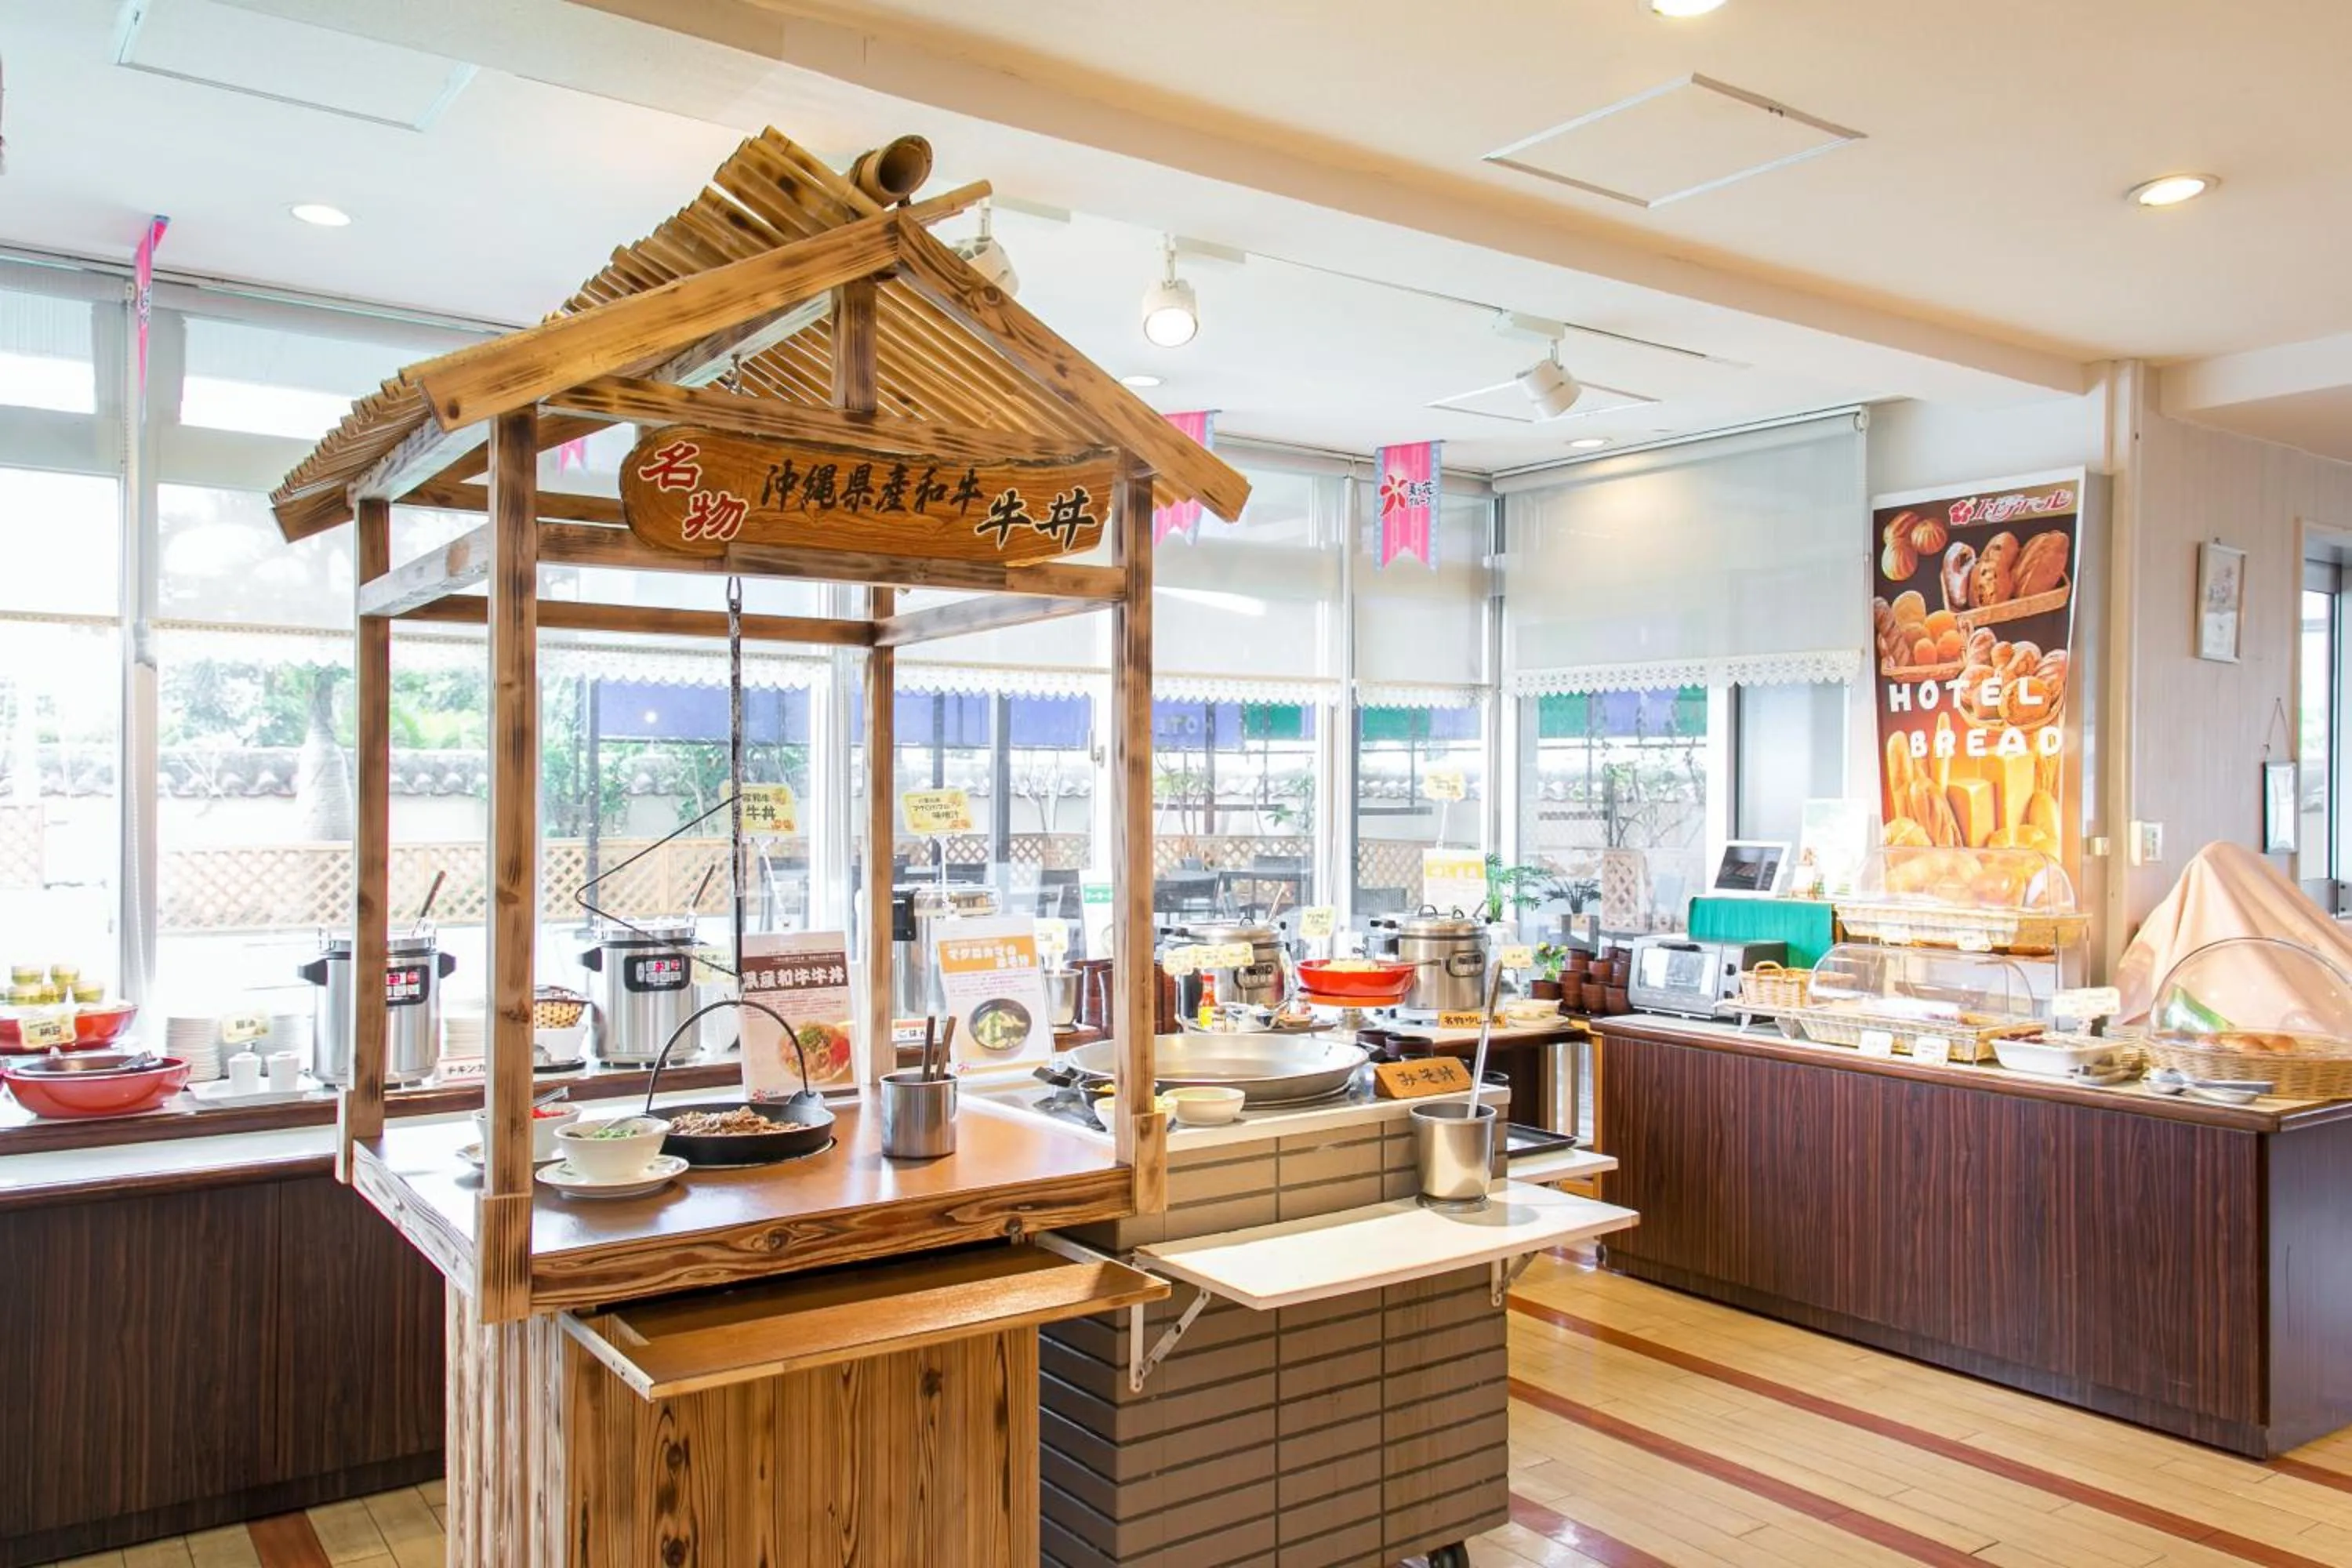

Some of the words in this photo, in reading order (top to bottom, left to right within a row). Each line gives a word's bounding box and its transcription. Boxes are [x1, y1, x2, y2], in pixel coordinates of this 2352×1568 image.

[638, 440, 750, 542] 名物
[760, 459, 985, 514] 沖縄県産和牛
[974, 487, 1098, 550] 牛丼
[1889, 676, 2044, 713] HOTEL
[1909, 726, 2064, 760] BREAD
[746, 804, 775, 821] 牛丼
